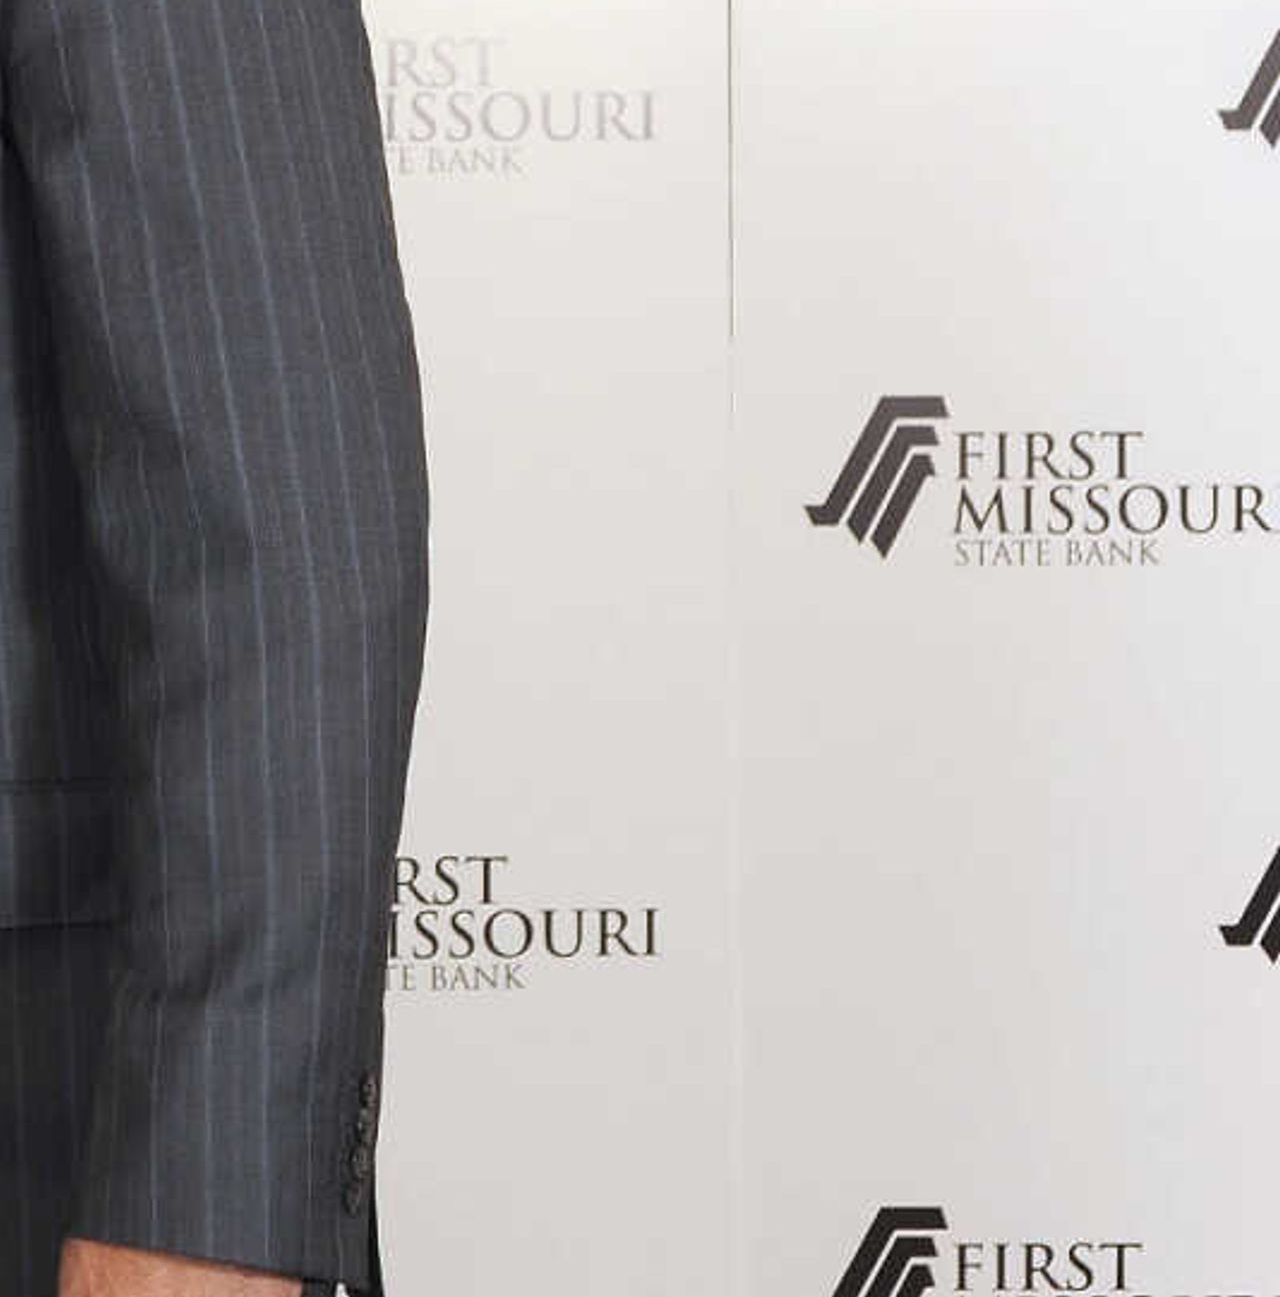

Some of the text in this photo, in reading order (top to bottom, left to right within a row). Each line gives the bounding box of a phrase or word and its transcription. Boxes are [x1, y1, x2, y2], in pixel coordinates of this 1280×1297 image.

[385, 36, 507, 87] RST
[385, 90, 658, 143] ISSOURI
[427, 146, 527, 175] BANK
[955, 430, 1143, 482] FIRST
[952, 483, 1280, 535] MISSOUR
[953, 539, 1161, 566] STATE BANK
[393, 855, 509, 906] RST
[388, 907, 660, 959] ISSOURI
[431, 963, 526, 991] BANK
[953, 1241, 1144, 1293] FIRST
